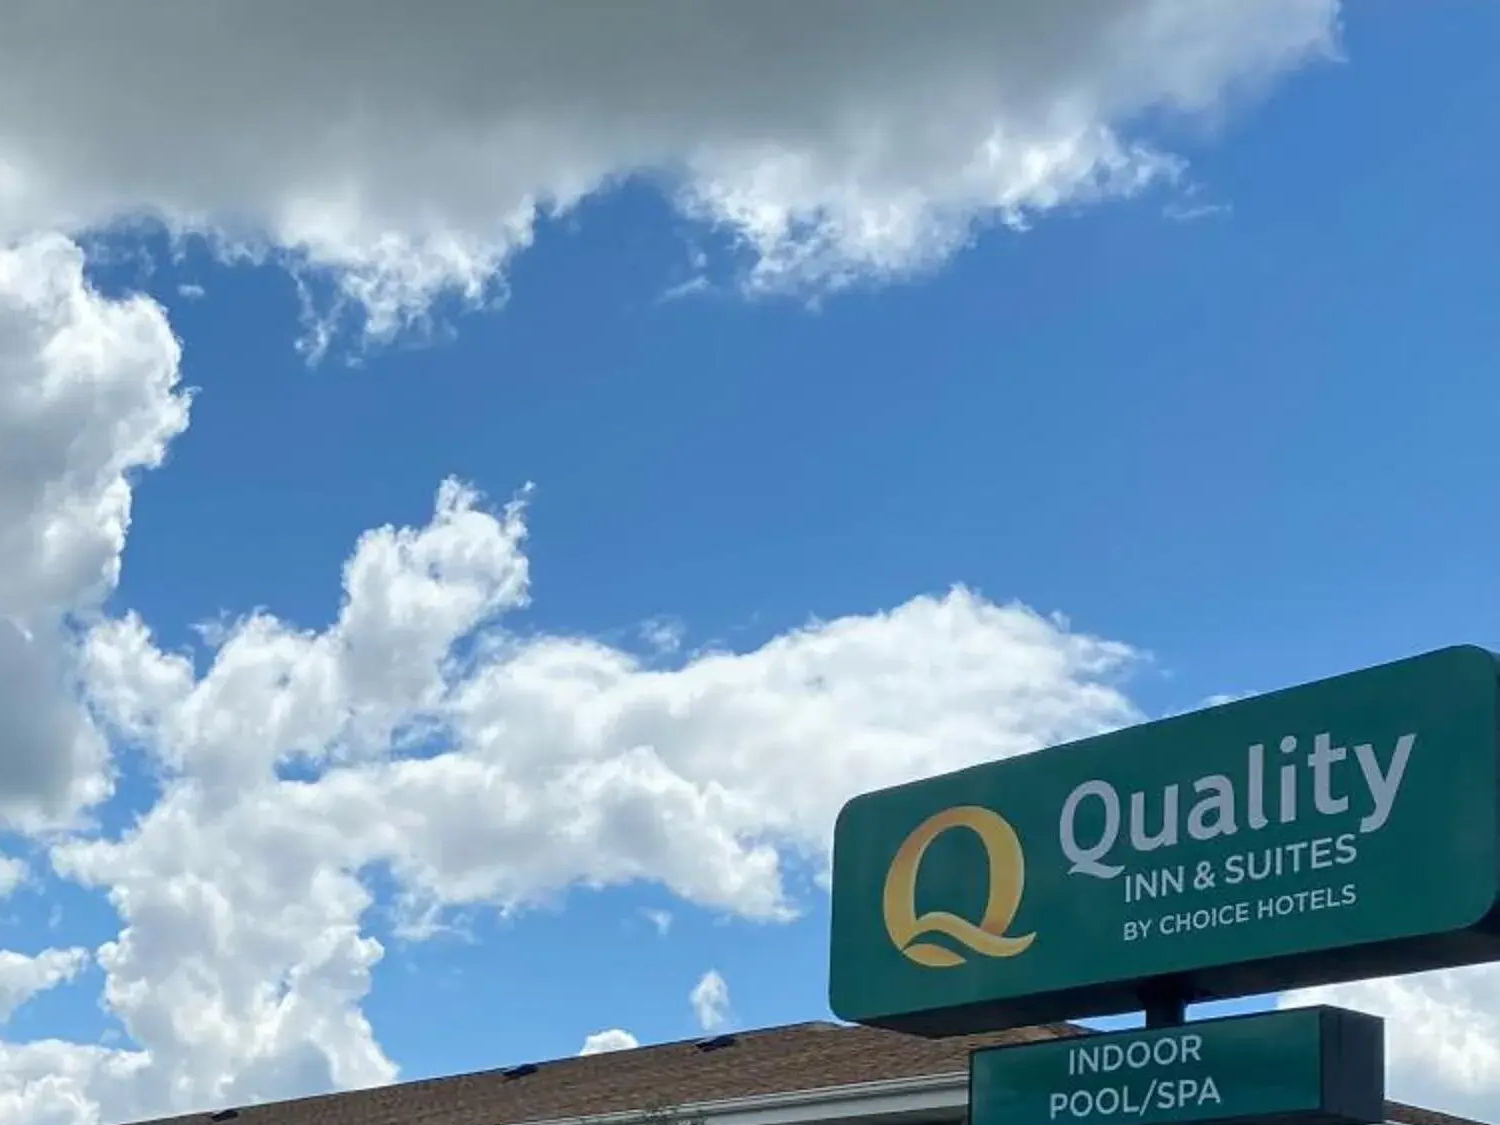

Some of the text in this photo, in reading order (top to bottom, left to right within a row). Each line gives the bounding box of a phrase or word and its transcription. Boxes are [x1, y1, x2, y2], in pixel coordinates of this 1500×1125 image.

[1059, 732, 1417, 878] Quality
[883, 805, 1036, 967] Q
[1125, 833, 1357, 903] INN & SUITES
[1123, 884, 1357, 942] BY CHOICE HOTELS
[1068, 1035, 1201, 1075] INDOOR
[1049, 1077, 1221, 1119] POOL/SPA
